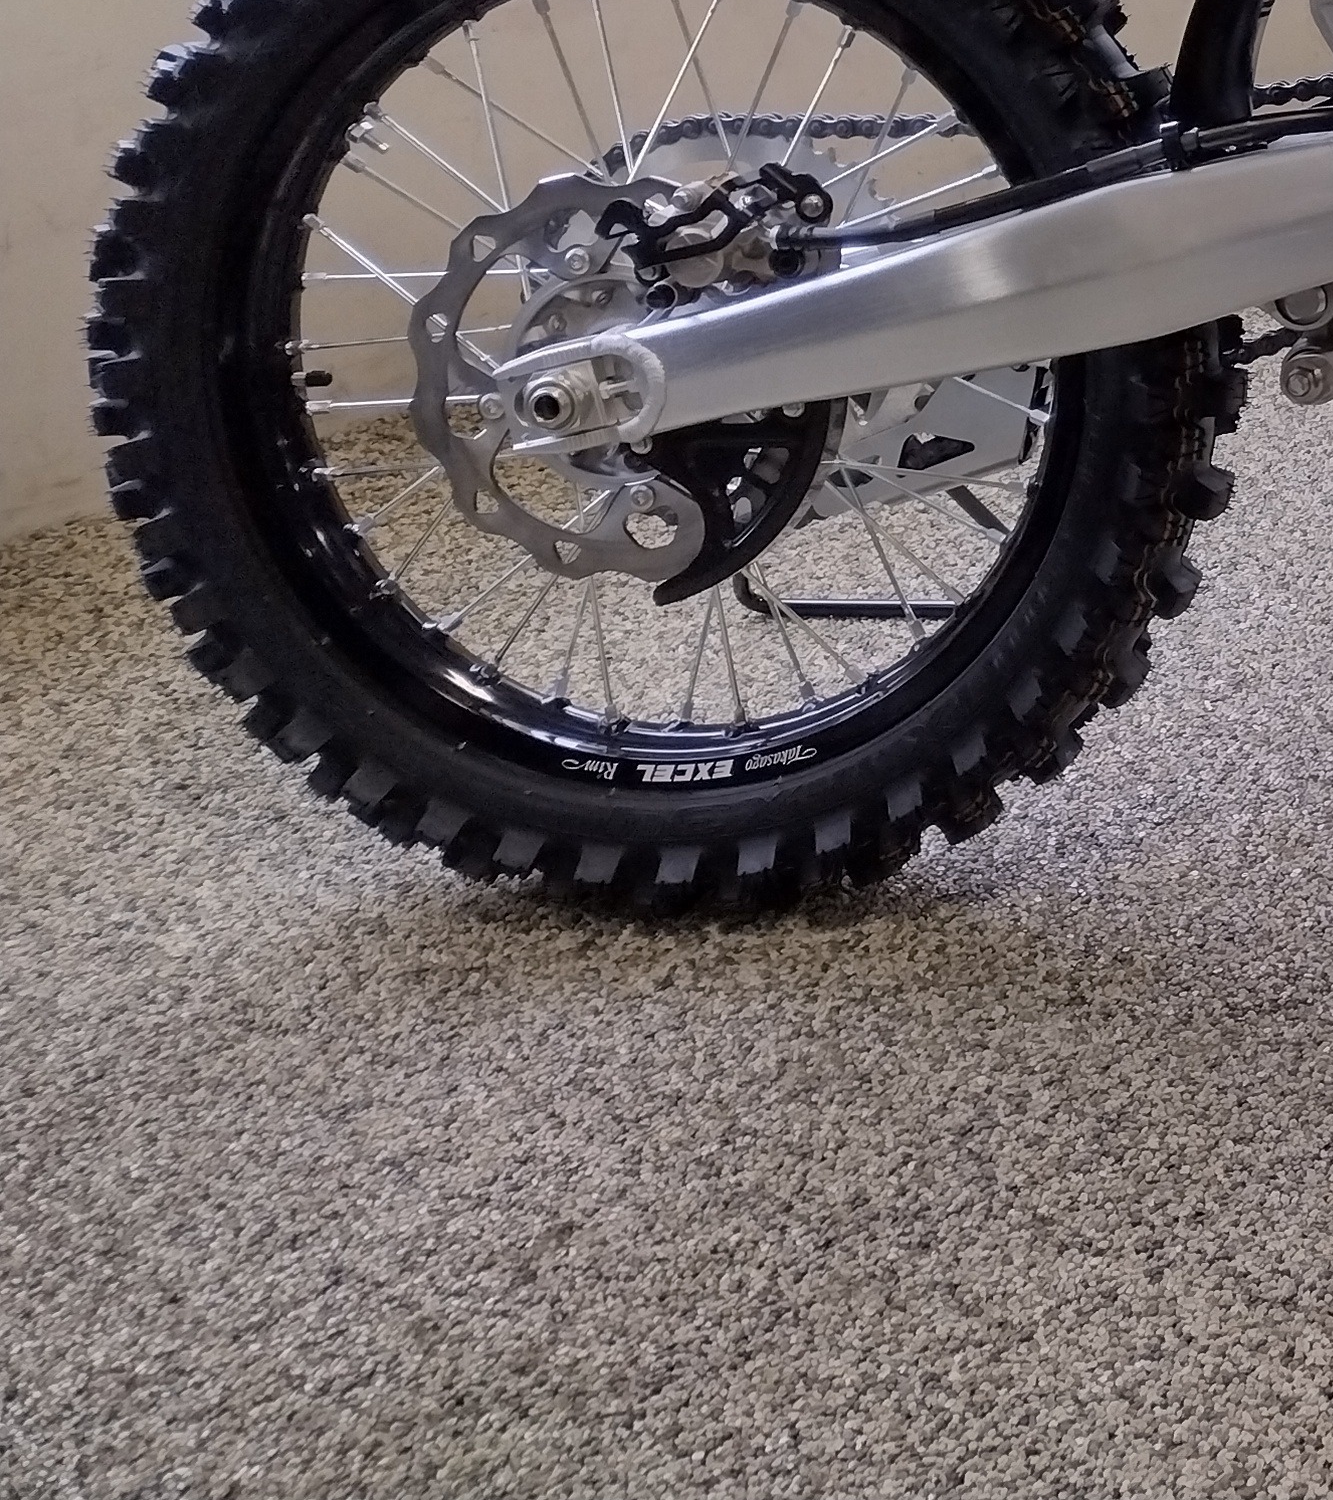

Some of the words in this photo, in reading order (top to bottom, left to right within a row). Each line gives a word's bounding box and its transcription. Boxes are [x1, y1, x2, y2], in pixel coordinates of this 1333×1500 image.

[574, 758, 619, 780] Rim
[636, 758, 735, 782] EXCEL
[745, 744, 811, 772] Takasago
